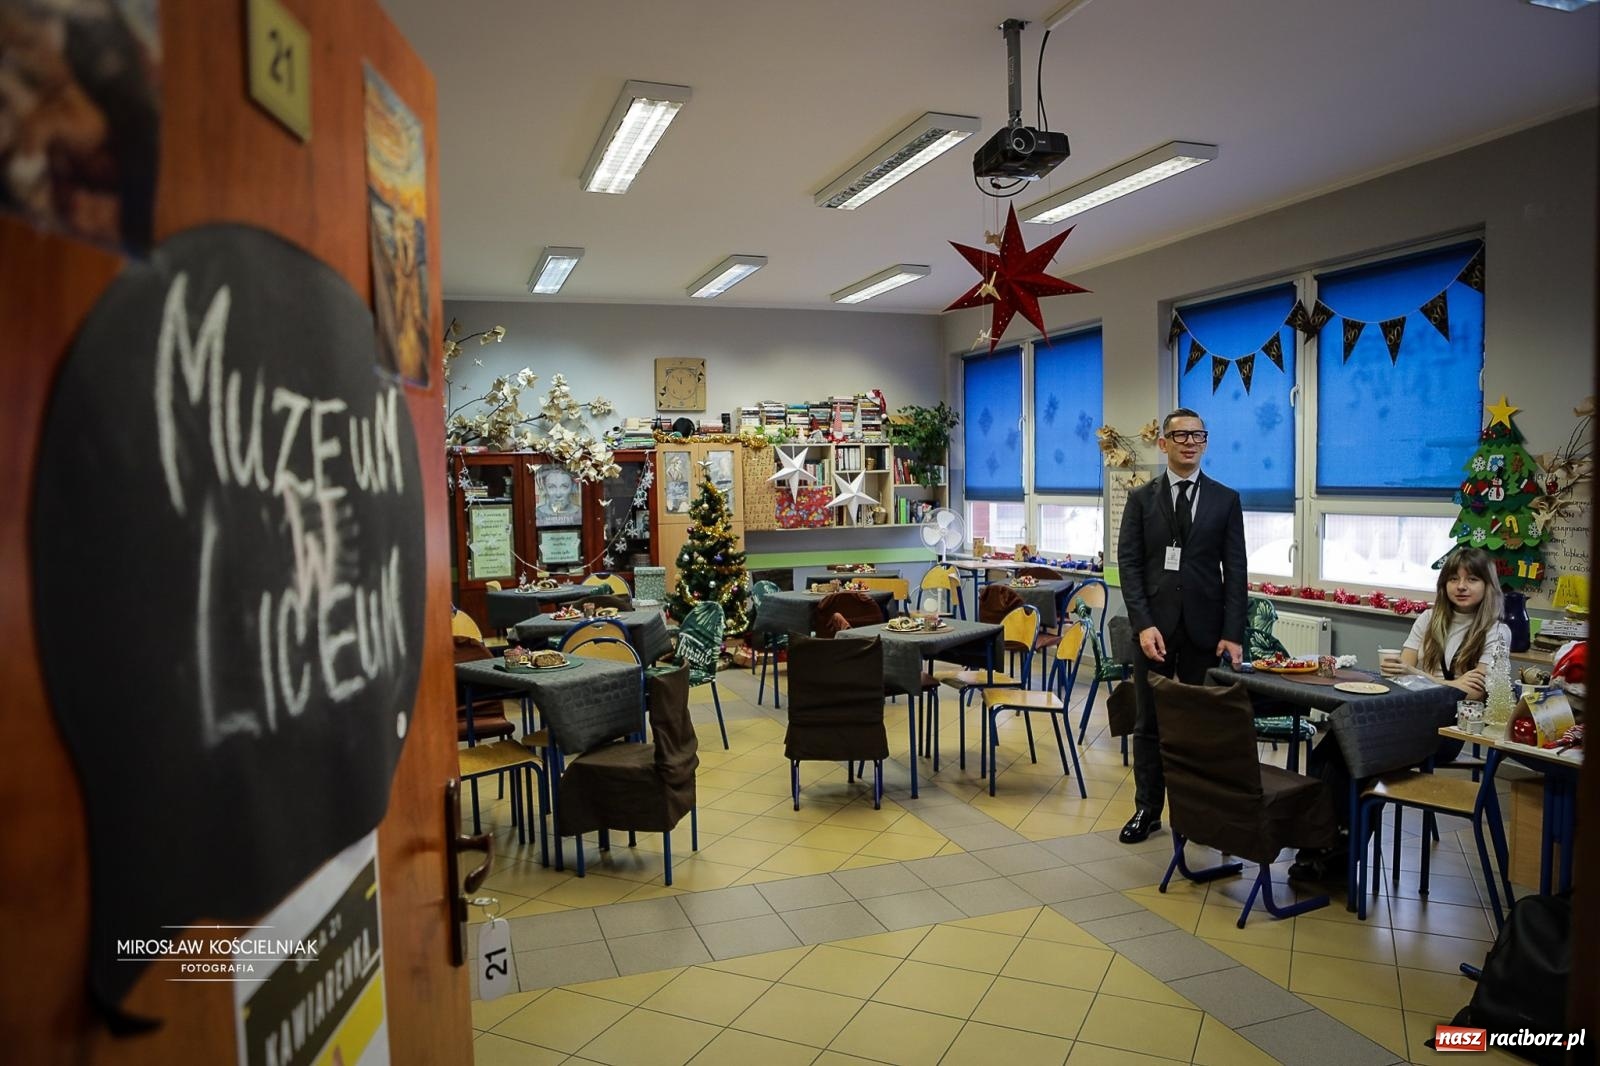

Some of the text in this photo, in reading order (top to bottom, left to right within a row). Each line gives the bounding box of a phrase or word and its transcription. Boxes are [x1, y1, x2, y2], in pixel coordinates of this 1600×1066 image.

[268, 28, 296, 94] 21
[1430, 302, 1446, 325] 80
[1343, 327, 1360, 346] 80
[1386, 325, 1402, 346] 80
[484, 947, 507, 980] 21
[265, 927, 371, 1066] KAWIARENKA
